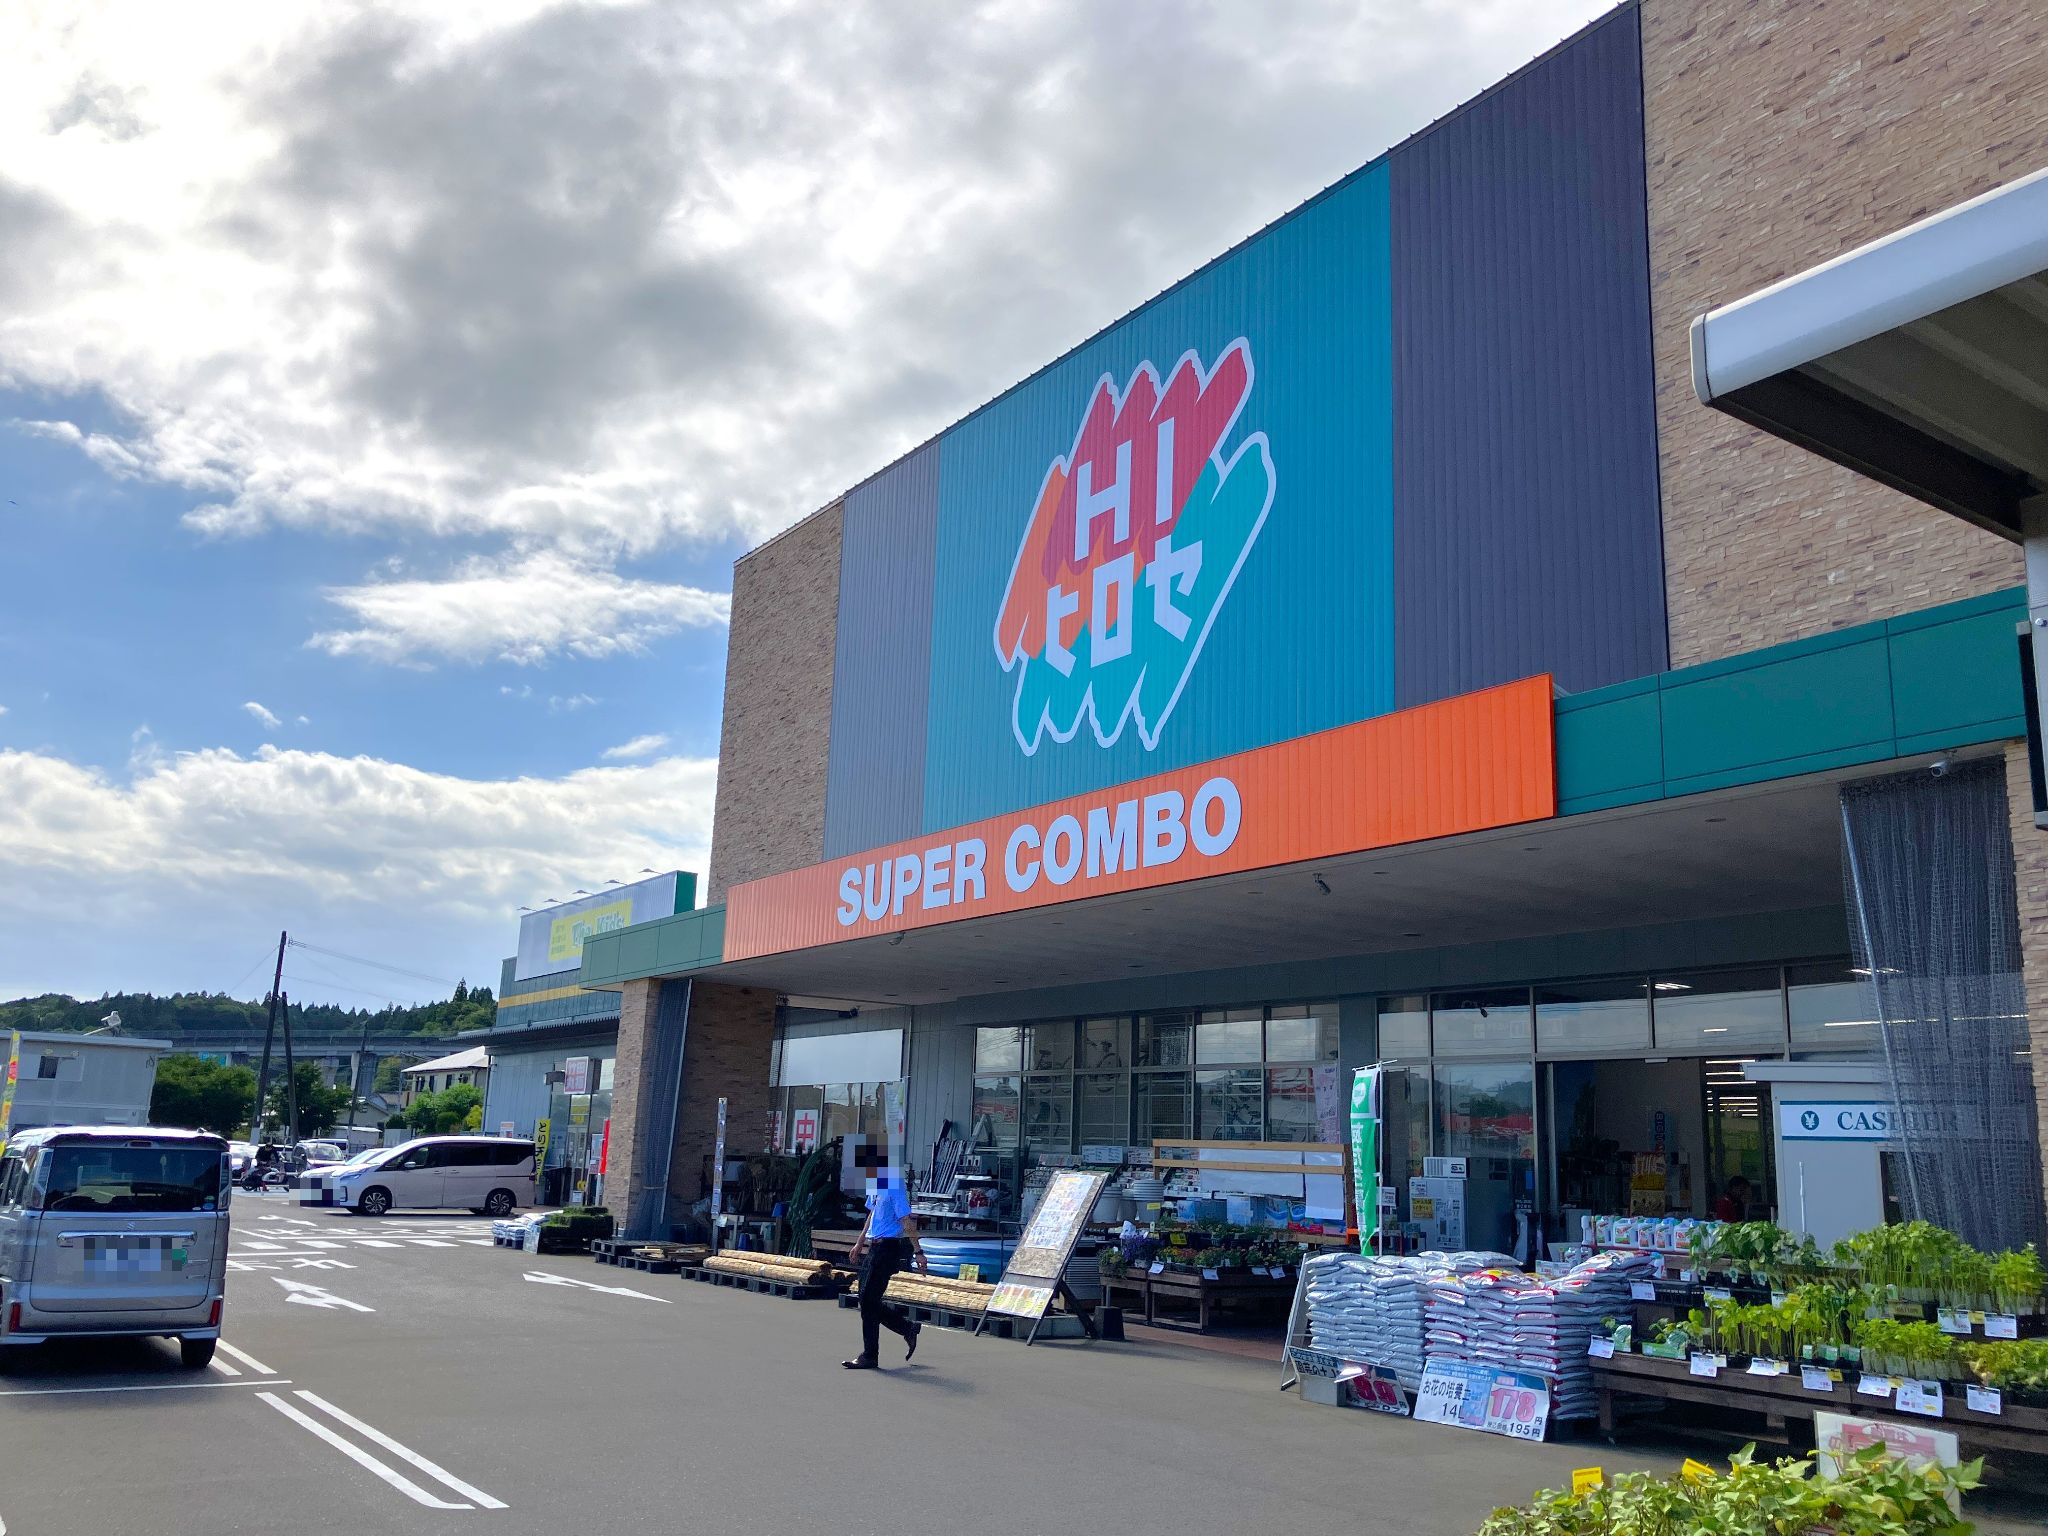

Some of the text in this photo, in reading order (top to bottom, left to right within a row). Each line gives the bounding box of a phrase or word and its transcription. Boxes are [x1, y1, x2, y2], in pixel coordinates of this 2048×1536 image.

[1074, 416, 1175, 562] HI
[1045, 535, 1203, 678] ヒロセ
[836, 777, 1242, 927] SUPER COMBO
[1422, 1378, 1471, 1401] お花の培養土
[1442, 1402, 1465, 1420] 14L
